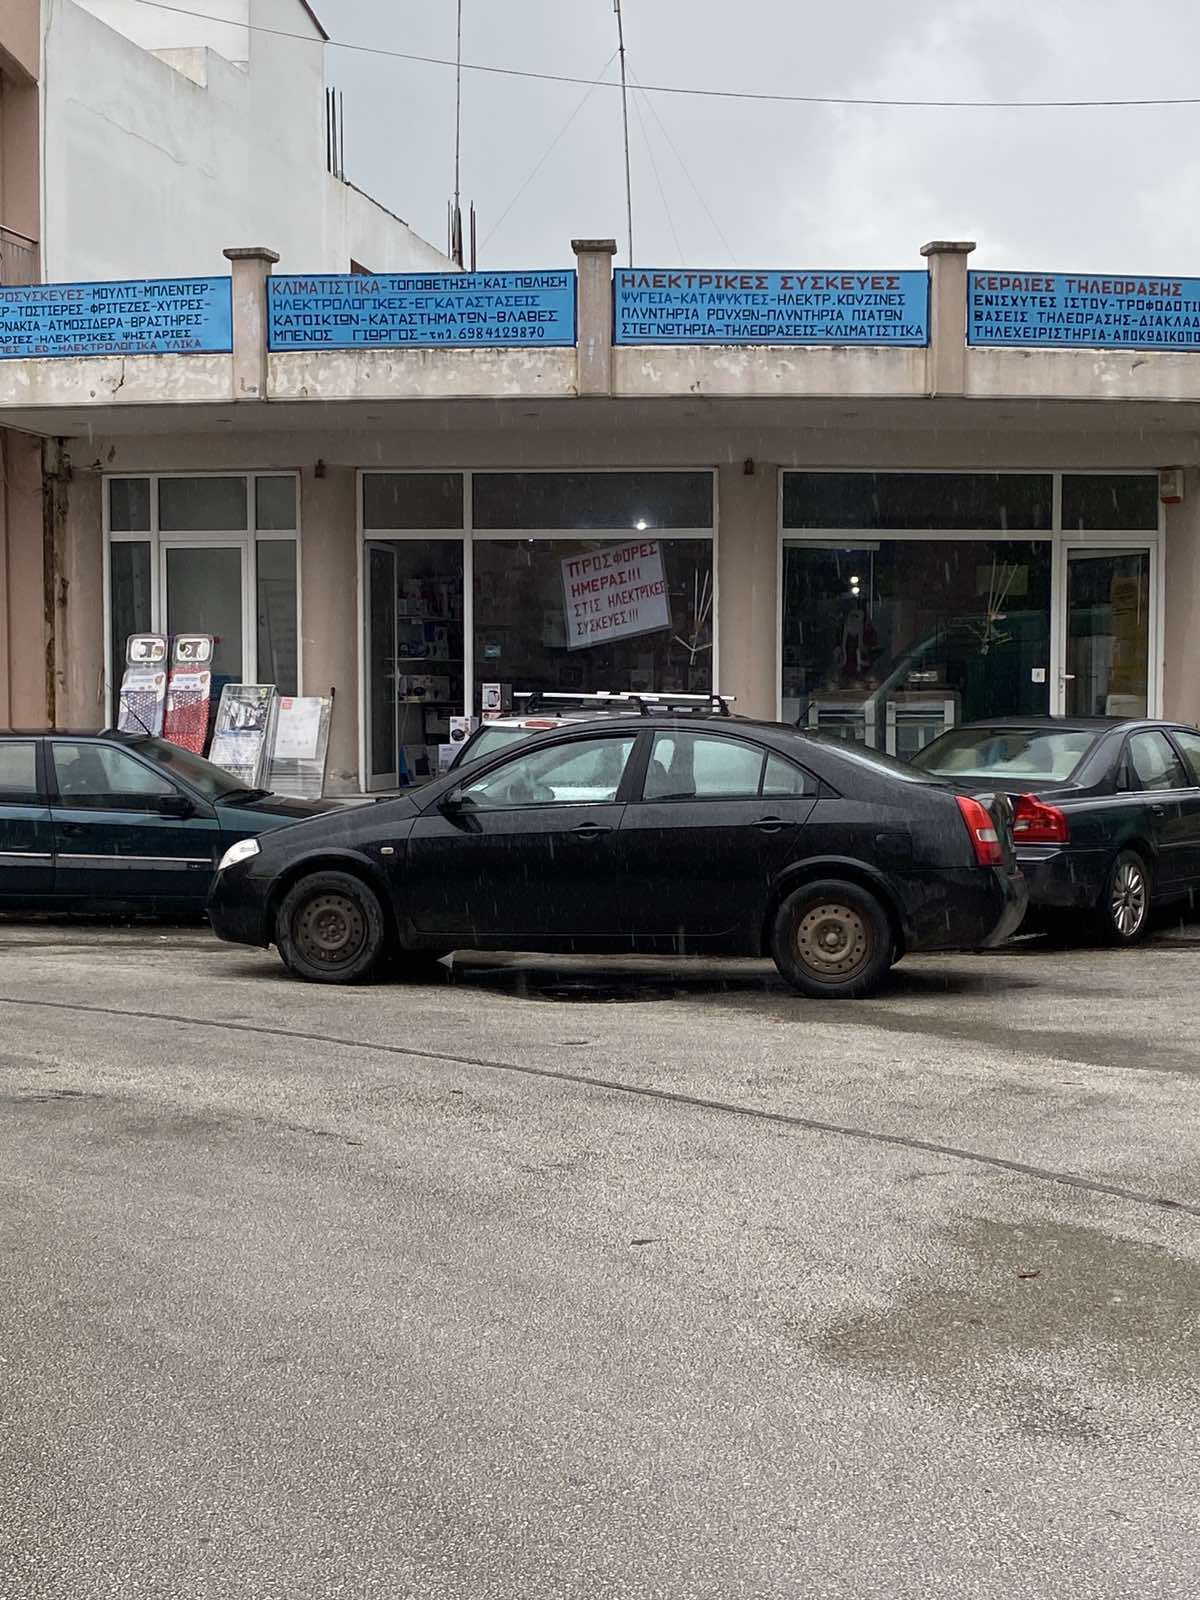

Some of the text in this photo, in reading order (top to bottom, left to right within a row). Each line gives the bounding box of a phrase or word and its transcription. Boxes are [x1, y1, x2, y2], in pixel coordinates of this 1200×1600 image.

[621, 273, 900, 290] ΗΛΕΚΤΡΙΚΕΣ ΣΥΣΚΕΥΕΣ
[974, 276, 1183, 297] ΚΕΡΑΙΕΣ ΤΗΛΕΟΡΑΣΗΣ
[973, 294, 1057, 308] ΕΝΙΣΧΥΤΕΣ
[621, 307, 699, 320] ΠΛΥΝΤΗΡΙΑ
[851, 309, 902, 321] ΠΙΑΤΩΝ
[973, 310, 1028, 323] ΒΑΣΕΙΣ
[122, 329, 192, 341] ΨΗΣΤΑΡΙΕΣ
[273, 329, 334, 342] ΜΠΕΝΟΣ
[164, 339, 202, 350] ΥΛΙΚΑ
[566, 541, 657, 578] ΠΡΟΣΦΟΡΕΣ
[574, 581, 665, 617] ΣΤΙΣ ΗΛΕΚΤΡΙΚΕΣ
